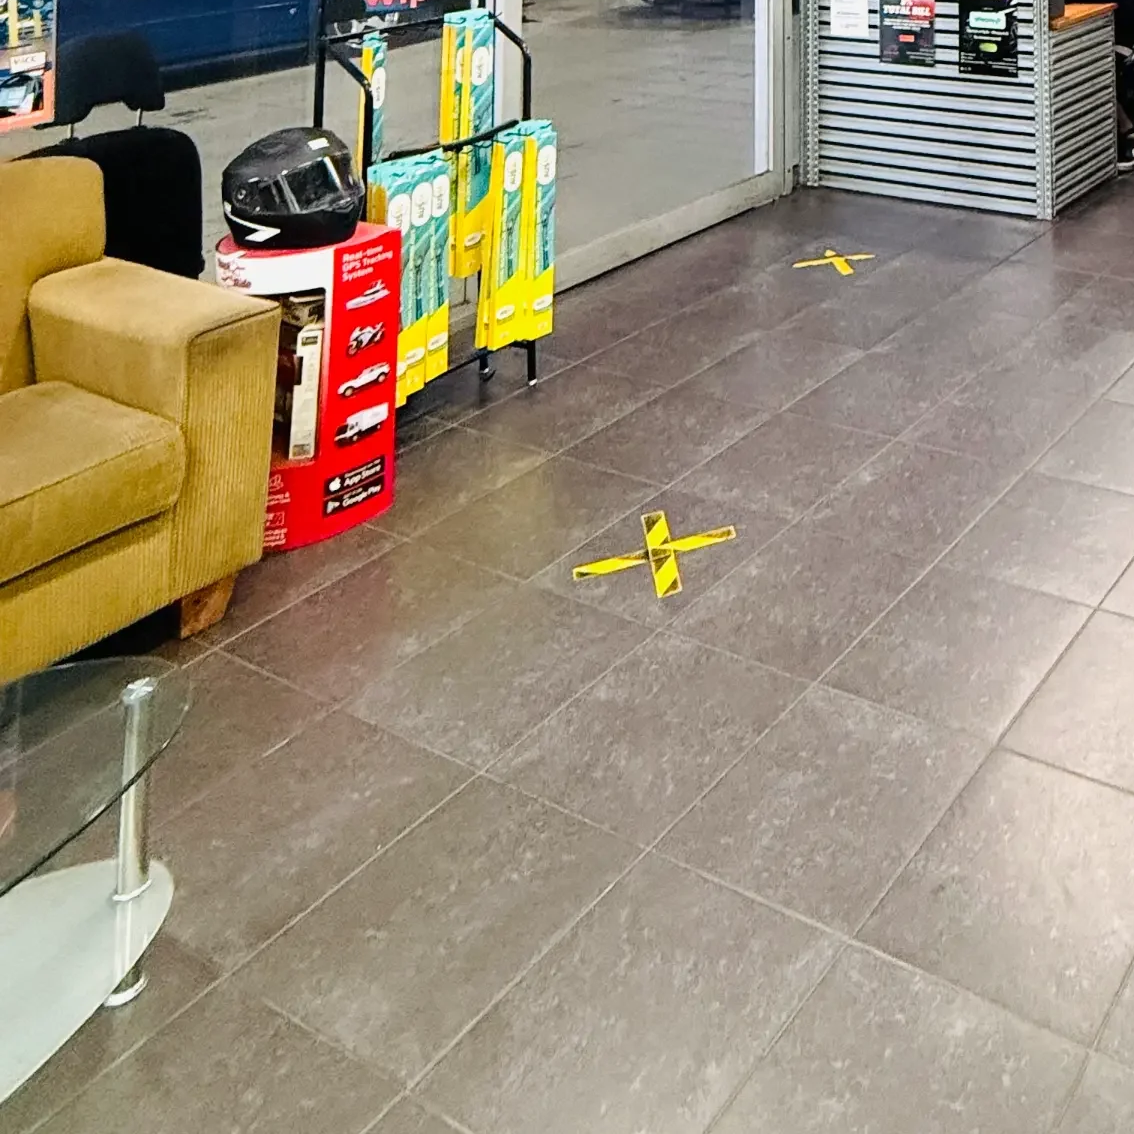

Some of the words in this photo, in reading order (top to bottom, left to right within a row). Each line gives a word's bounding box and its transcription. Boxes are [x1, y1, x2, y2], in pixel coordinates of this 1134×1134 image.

[342, 245, 384, 264] Real-time
[342, 260, 362, 272] GPS
[362, 250, 393, 267] Tracking
[342, 266, 374, 282] System
[344, 474, 361, 487] App
[361, 464, 381, 479] Store
[342, 491, 368, 508] Google
[367, 484, 381, 496] Play
